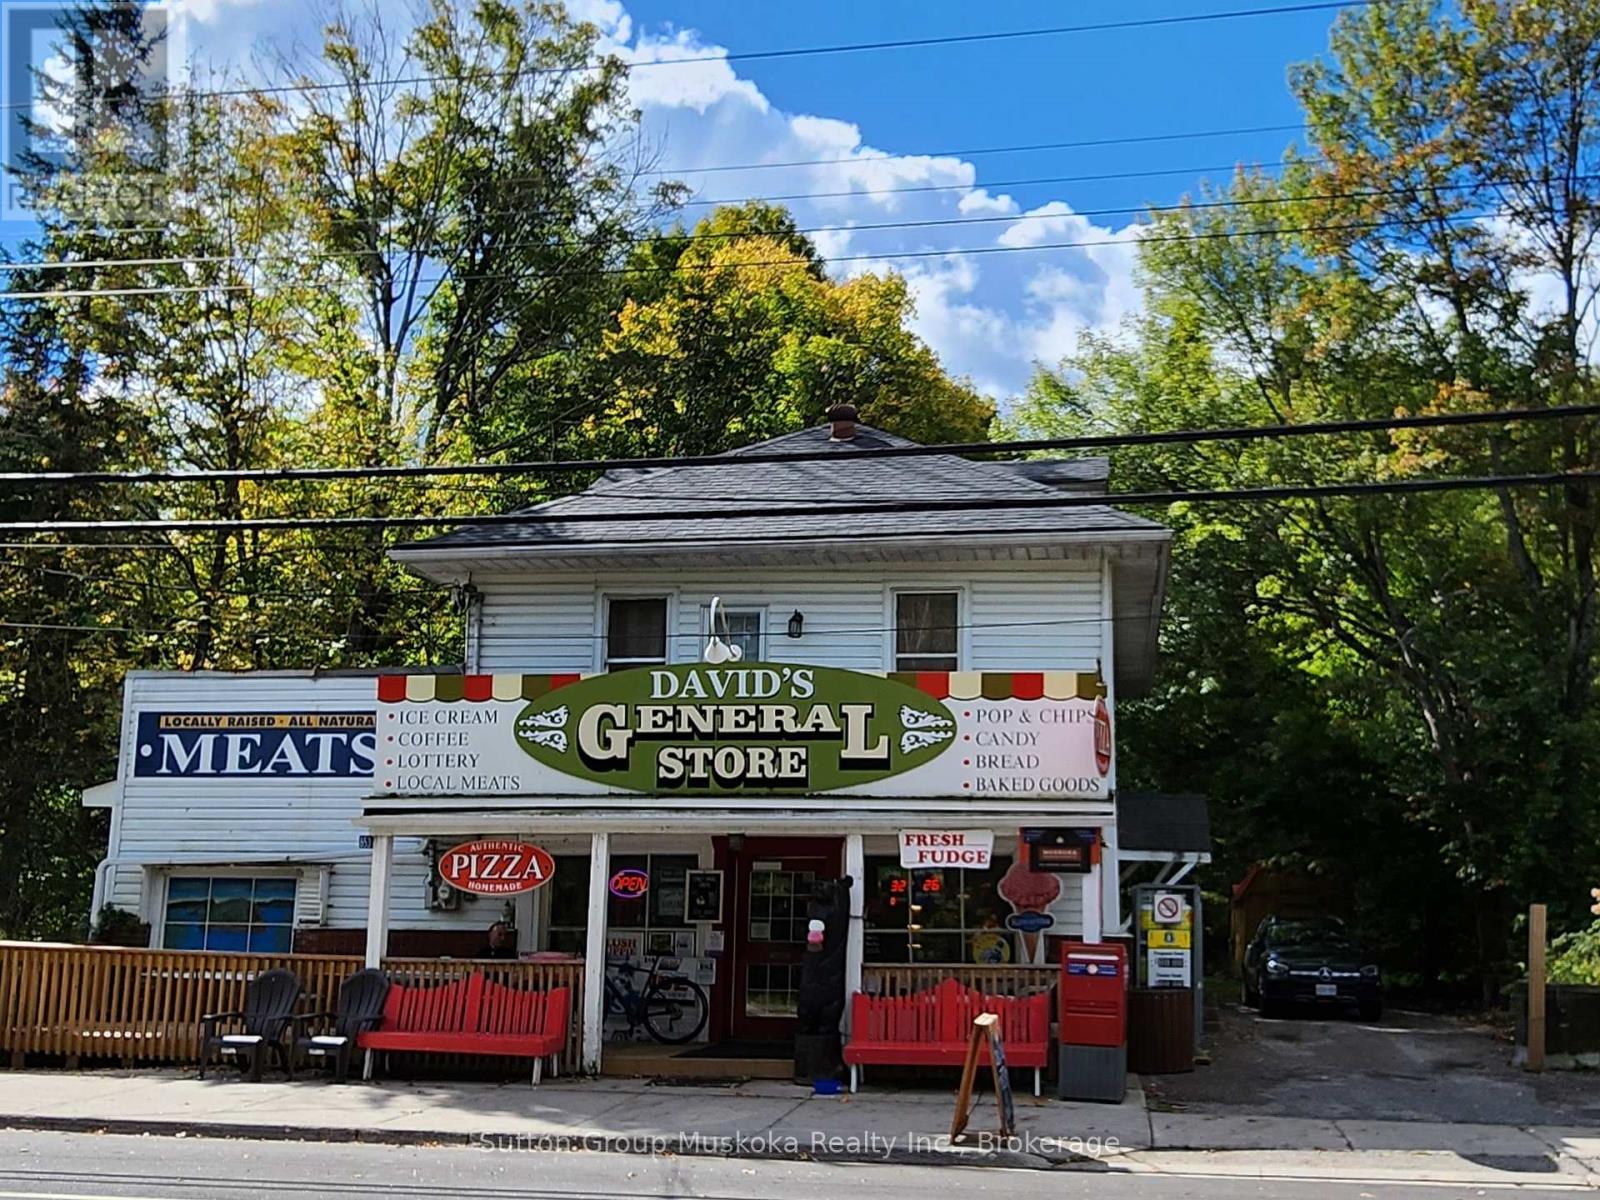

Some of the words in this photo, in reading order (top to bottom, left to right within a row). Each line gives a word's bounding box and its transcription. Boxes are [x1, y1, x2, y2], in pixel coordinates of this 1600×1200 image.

[651, 669, 815, 698] DAVID'S
[165, 716, 222, 727] LOCALLY
[228, 716, 276, 727] RAISED
[289, 716, 313, 727] ALL
[318, 716, 376, 727] NATURA
[400, 710, 429, 725] ICE
[434, 710, 498, 725] CREAM
[976, 709, 1013, 723] POP
[1018, 710, 1031, 723] &
[1039, 709, 1096, 724] CHIPS
[578, 703, 888, 760] GENERAL
[975, 731, 1040, 746] CANDY
[398, 732, 469, 747] COFFEE
[156, 732, 376, 774] MEATS
[398, 754, 480, 769] LOTTERY
[658, 747, 807, 779] STORE
[976, 754, 1039, 769] BREAD
[397, 775, 457, 791] LOCAL
[461, 775, 520, 791] MEATS
[976, 777, 1035, 792] BAKED
[1039, 777, 1100, 792] GOODS
[905, 833, 964, 846] FRESH
[470, 842, 524, 853] AUTHENTIC
[918, 850, 988, 864] FUDGE
[450, 854, 543, 879] PIZZA
[467, 881, 522, 892] HOMEMADE
[612, 876, 647, 891] OPEN
[923, 879, 940, 891] 26
